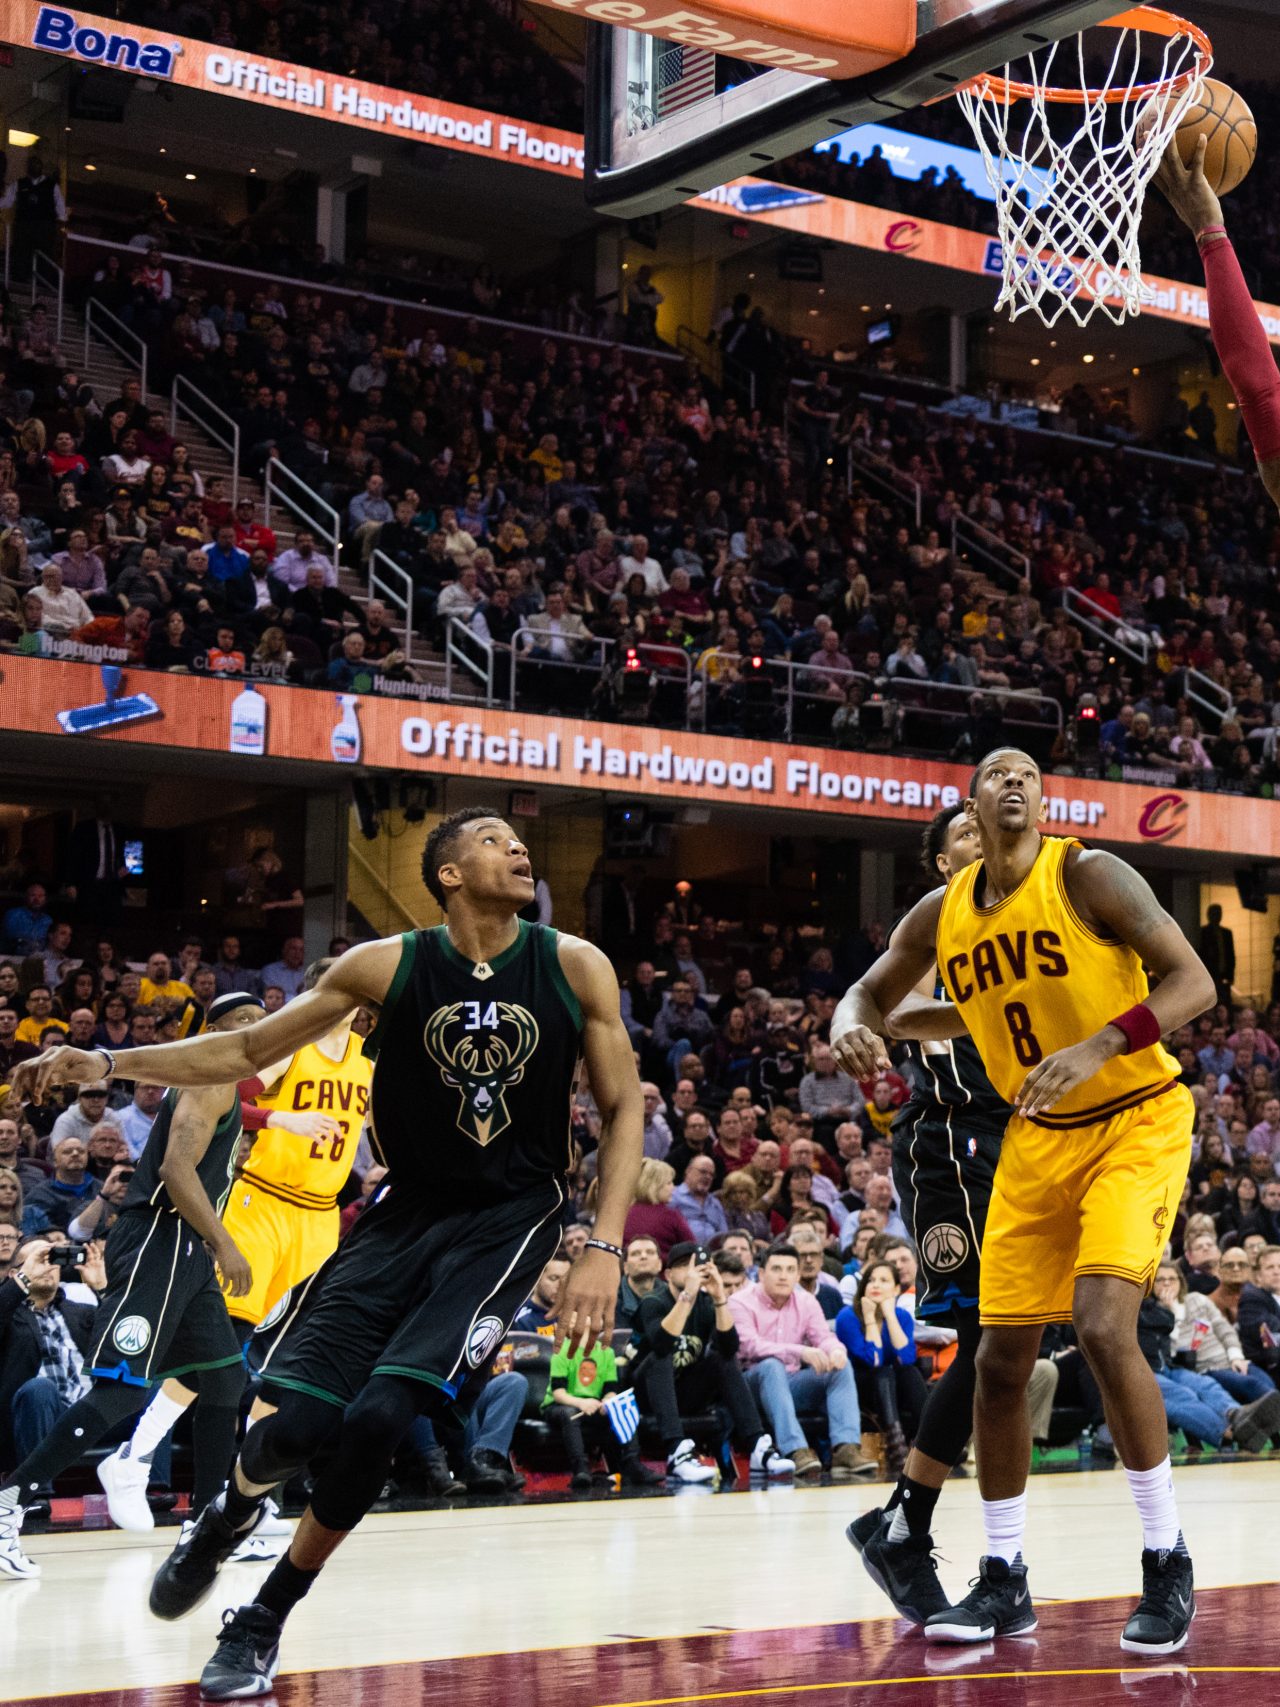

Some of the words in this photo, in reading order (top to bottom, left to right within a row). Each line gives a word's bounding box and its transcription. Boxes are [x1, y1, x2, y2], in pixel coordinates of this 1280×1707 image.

[33, 6, 175, 78] Bona
[630, 10, 839, 70] Farm
[205, 53, 324, 108] Official
[332, 82, 492, 147] Hardwood
[373, 674, 450, 701] Huntington
[401, 716, 558, 768] Official
[574, 735, 773, 790] Hardwood
[786, 760, 960, 809] Floorcare
[947, 930, 1068, 1004] CAVS
[464, 1001, 500, 1030] 34
[1004, 1001, 1042, 1067] 8
[292, 1080, 369, 1116] CAVS
